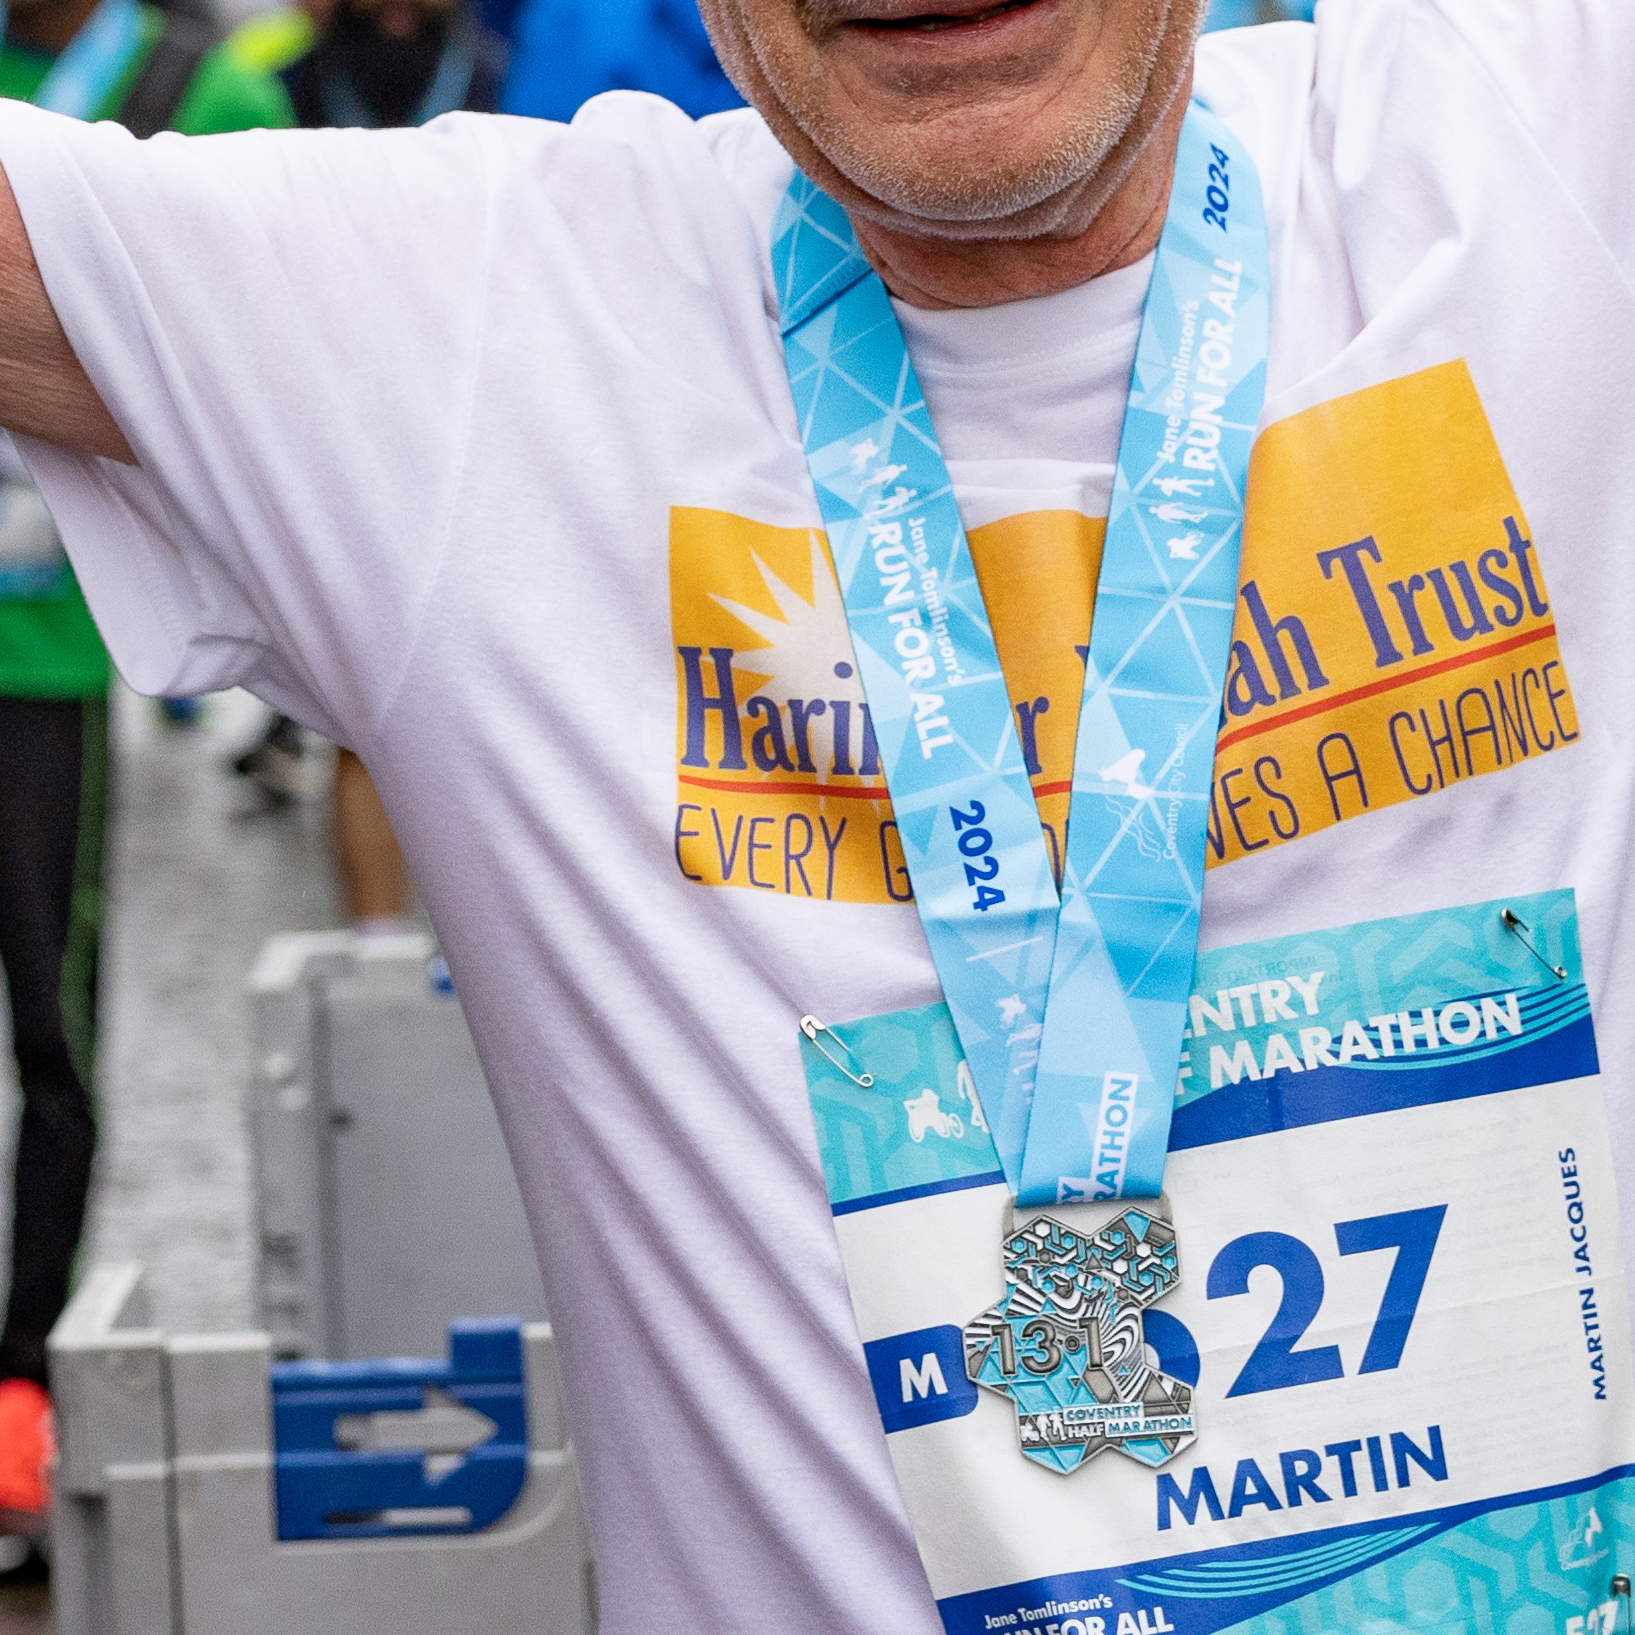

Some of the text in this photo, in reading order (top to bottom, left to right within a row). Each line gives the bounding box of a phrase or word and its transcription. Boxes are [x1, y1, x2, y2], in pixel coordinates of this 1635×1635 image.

[1202, 142, 1231, 233] 2024
[1157, 299, 1199, 463] Jane Tomlinson's
[1183, 258, 1243, 471] RUN FOR ALL
[869, 522, 954, 760] RUN FOR ALL
[908, 516, 965, 686] Jane Tomlinson's
[1316, 515, 1549, 668] Trust
[675, 803, 847, 901] EVERY
[1317, 732, 1369, 821] A
[1389, 660, 1578, 795] CHANCE
[1163, 723, 1189, 859] Coventry City Council
[950, 800, 1006, 912] 2024
[1183, 971, 1325, 1039] NTRY
[1209, 992, 1524, 1089] MARATHON
[1558, 1147, 1607, 1400] MARTIN JACQUES
[899, 1352, 949, 1403] M
[1065, 1404, 1141, 1422] COVENTRY
[1068, 1415, 1193, 1438] HALF MARATHON
[1156, 1425, 1449, 1531] MARTIN
[984, 1594, 1113, 1630] Jane Tomlinson's
[1116, 1605, 1175, 1635] ALL
